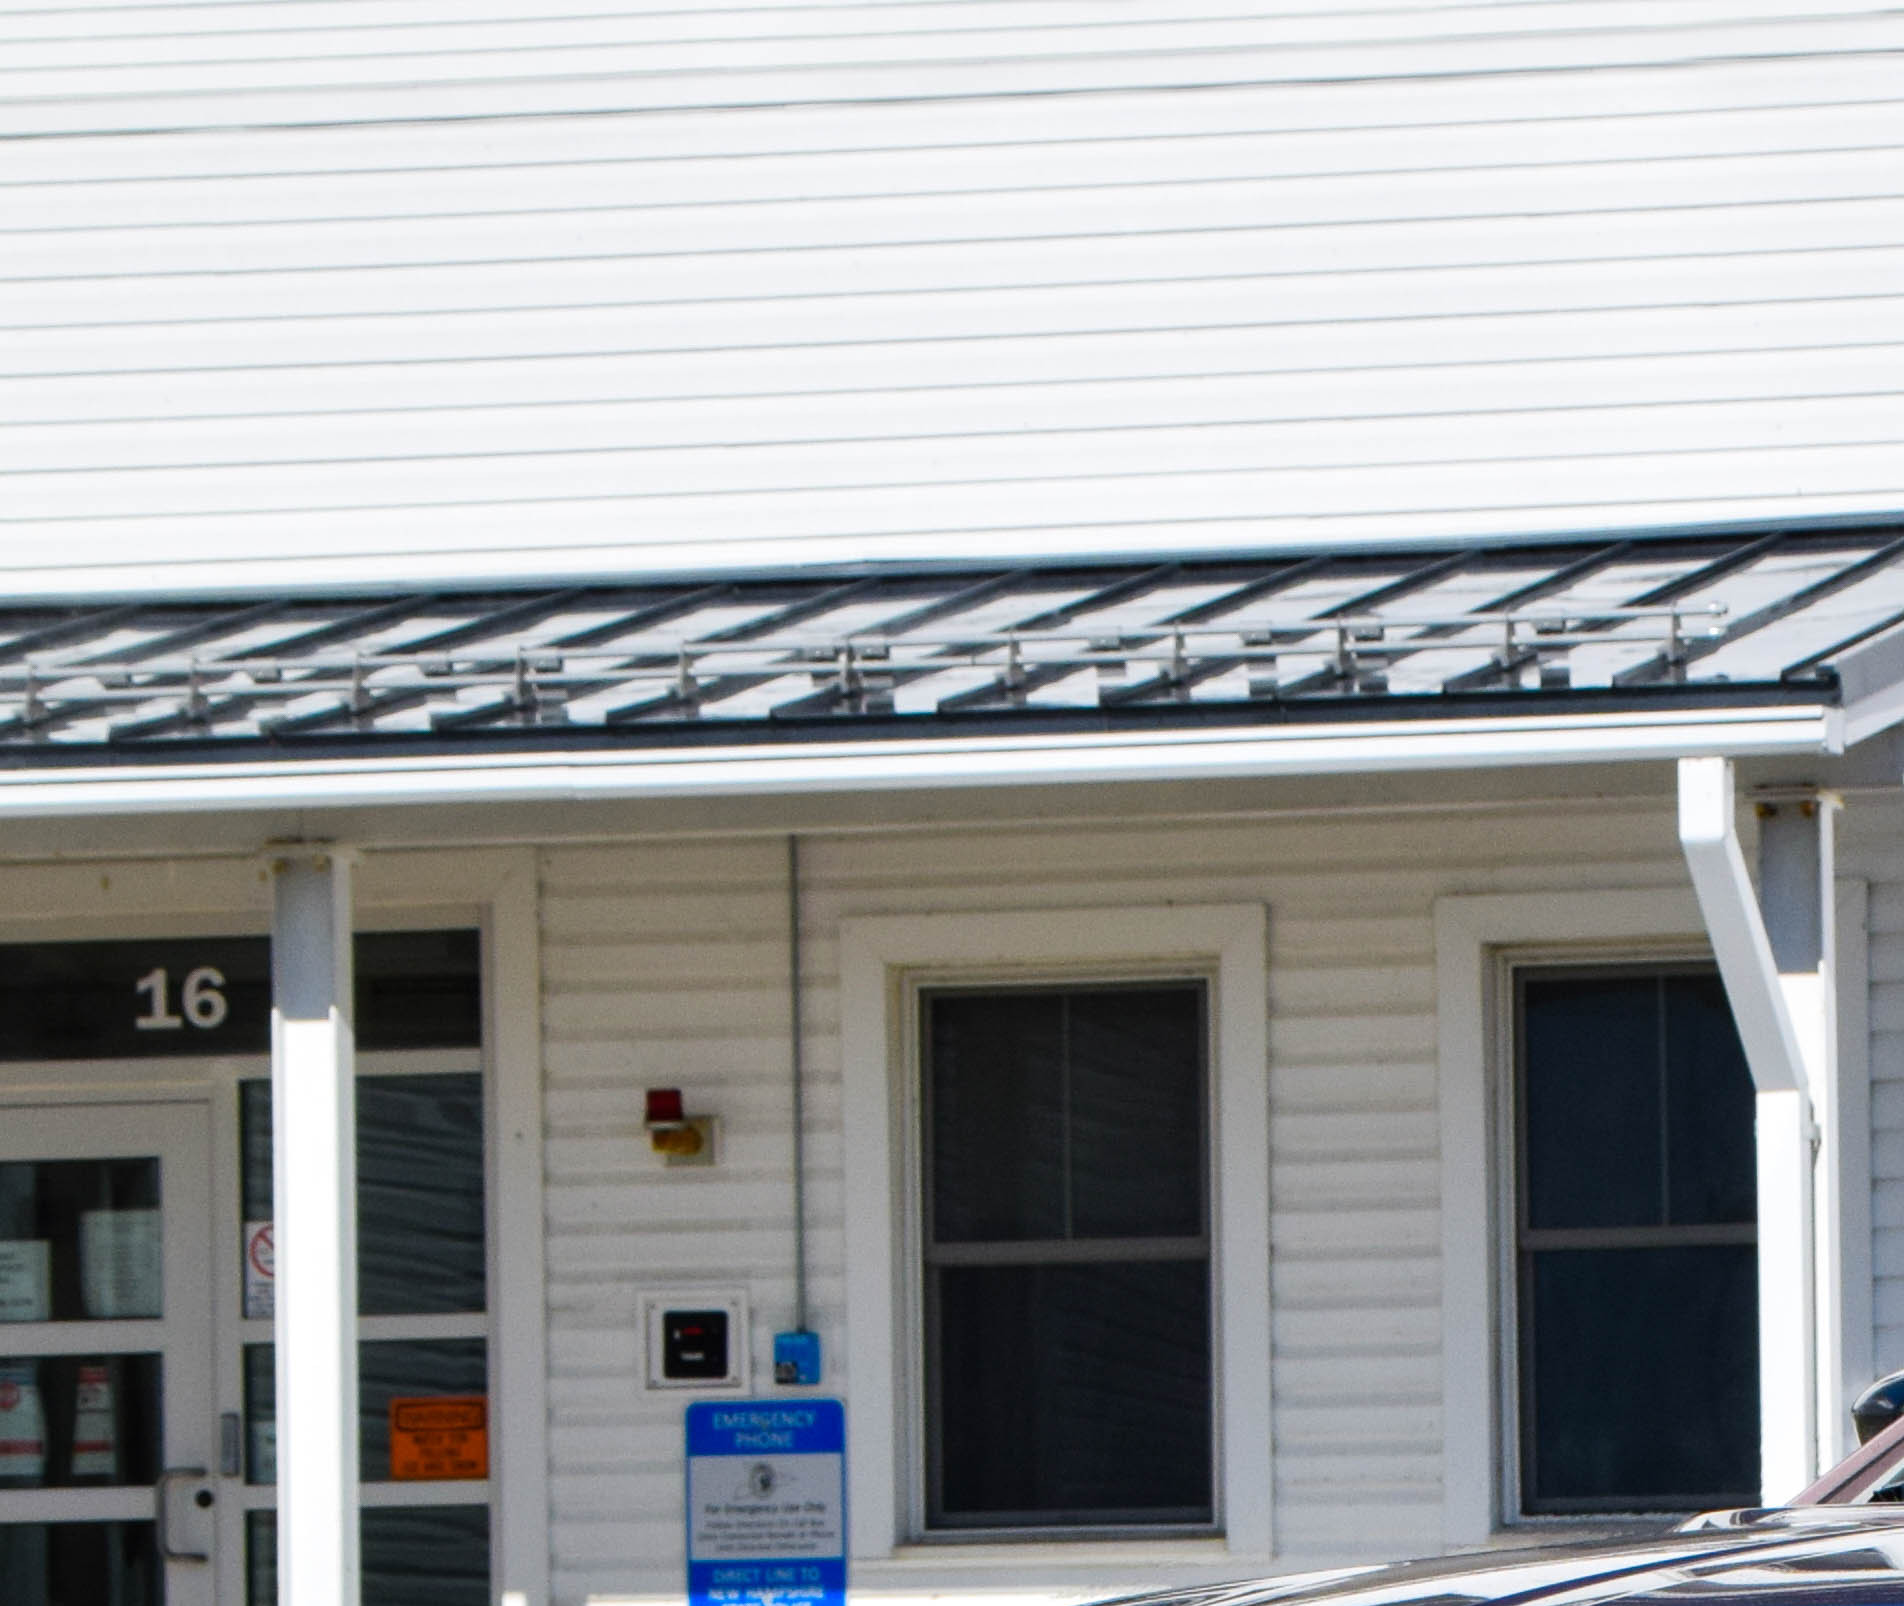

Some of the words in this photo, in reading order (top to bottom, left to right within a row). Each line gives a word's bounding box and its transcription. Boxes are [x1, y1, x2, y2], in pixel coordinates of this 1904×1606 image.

[135, 967, 228, 1030] 16
[713, 1410, 816, 1430] EMERGENCY
[736, 1432, 793, 1448] PHONE
[712, 1568, 759, 1583] DIRECT
[765, 1568, 794, 1582] LINE
[801, 1567, 820, 1581] TO
